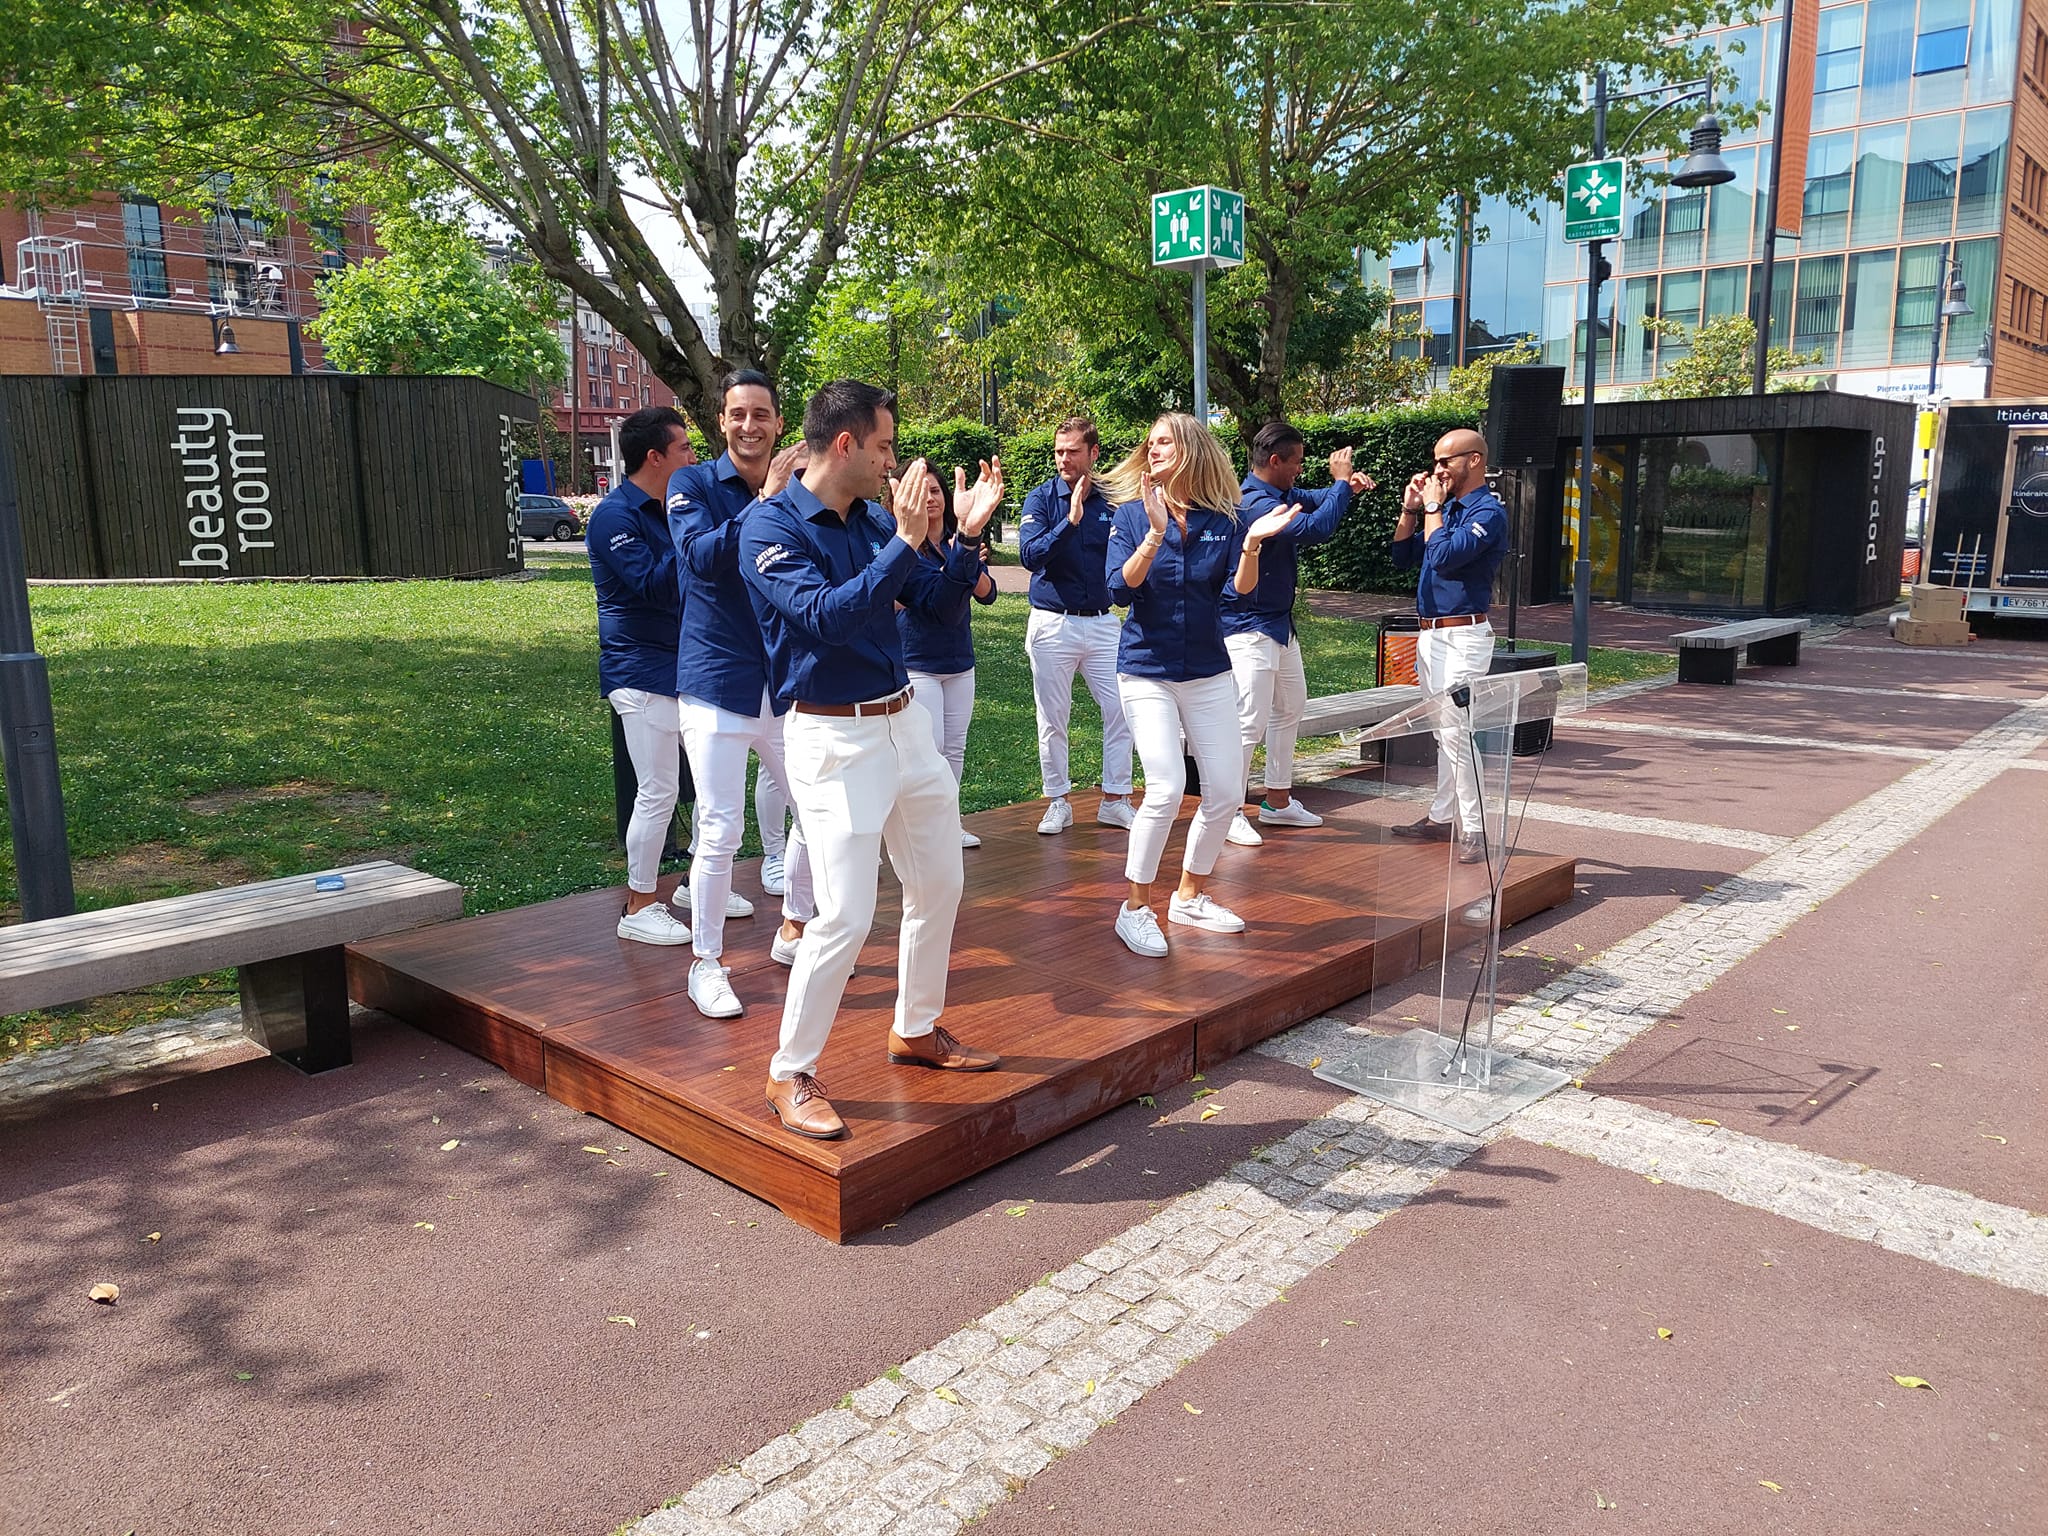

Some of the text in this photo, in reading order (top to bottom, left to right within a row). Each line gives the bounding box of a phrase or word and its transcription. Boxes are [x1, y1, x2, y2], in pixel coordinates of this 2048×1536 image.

[170, 407, 233, 570] beauty
[227, 429, 275, 553] room
[499, 413, 518, 563] beauty
[755, 543, 783, 567] ARTURO
